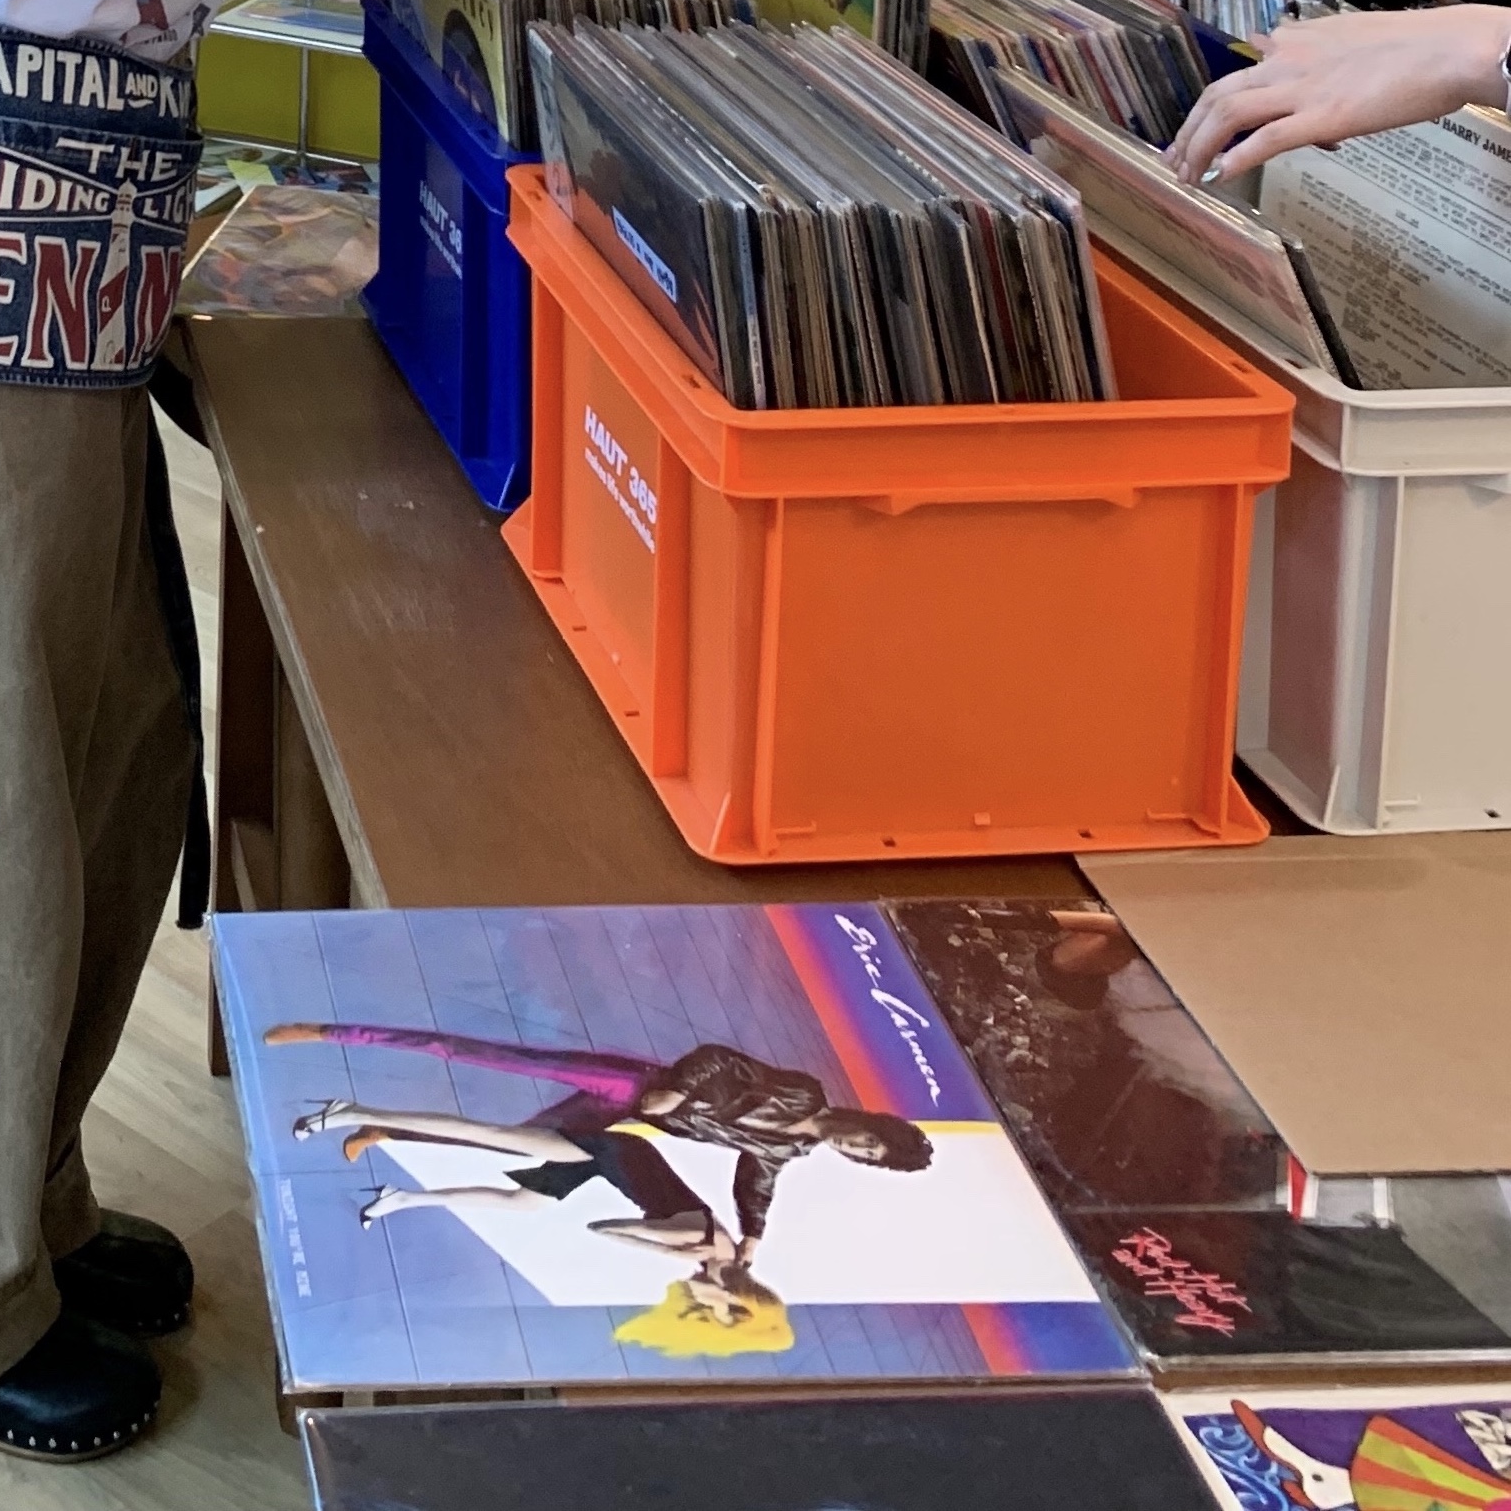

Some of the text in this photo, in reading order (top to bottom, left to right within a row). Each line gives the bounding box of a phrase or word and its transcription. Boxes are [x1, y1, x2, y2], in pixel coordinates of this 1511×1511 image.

[125, 71, 158, 97] AND
[1442, 118, 1481, 146] HARRY
[55, 137, 182, 183] THE
[585, 404, 657, 525] HAUT 365
[834, 914, 882, 989] Eric
